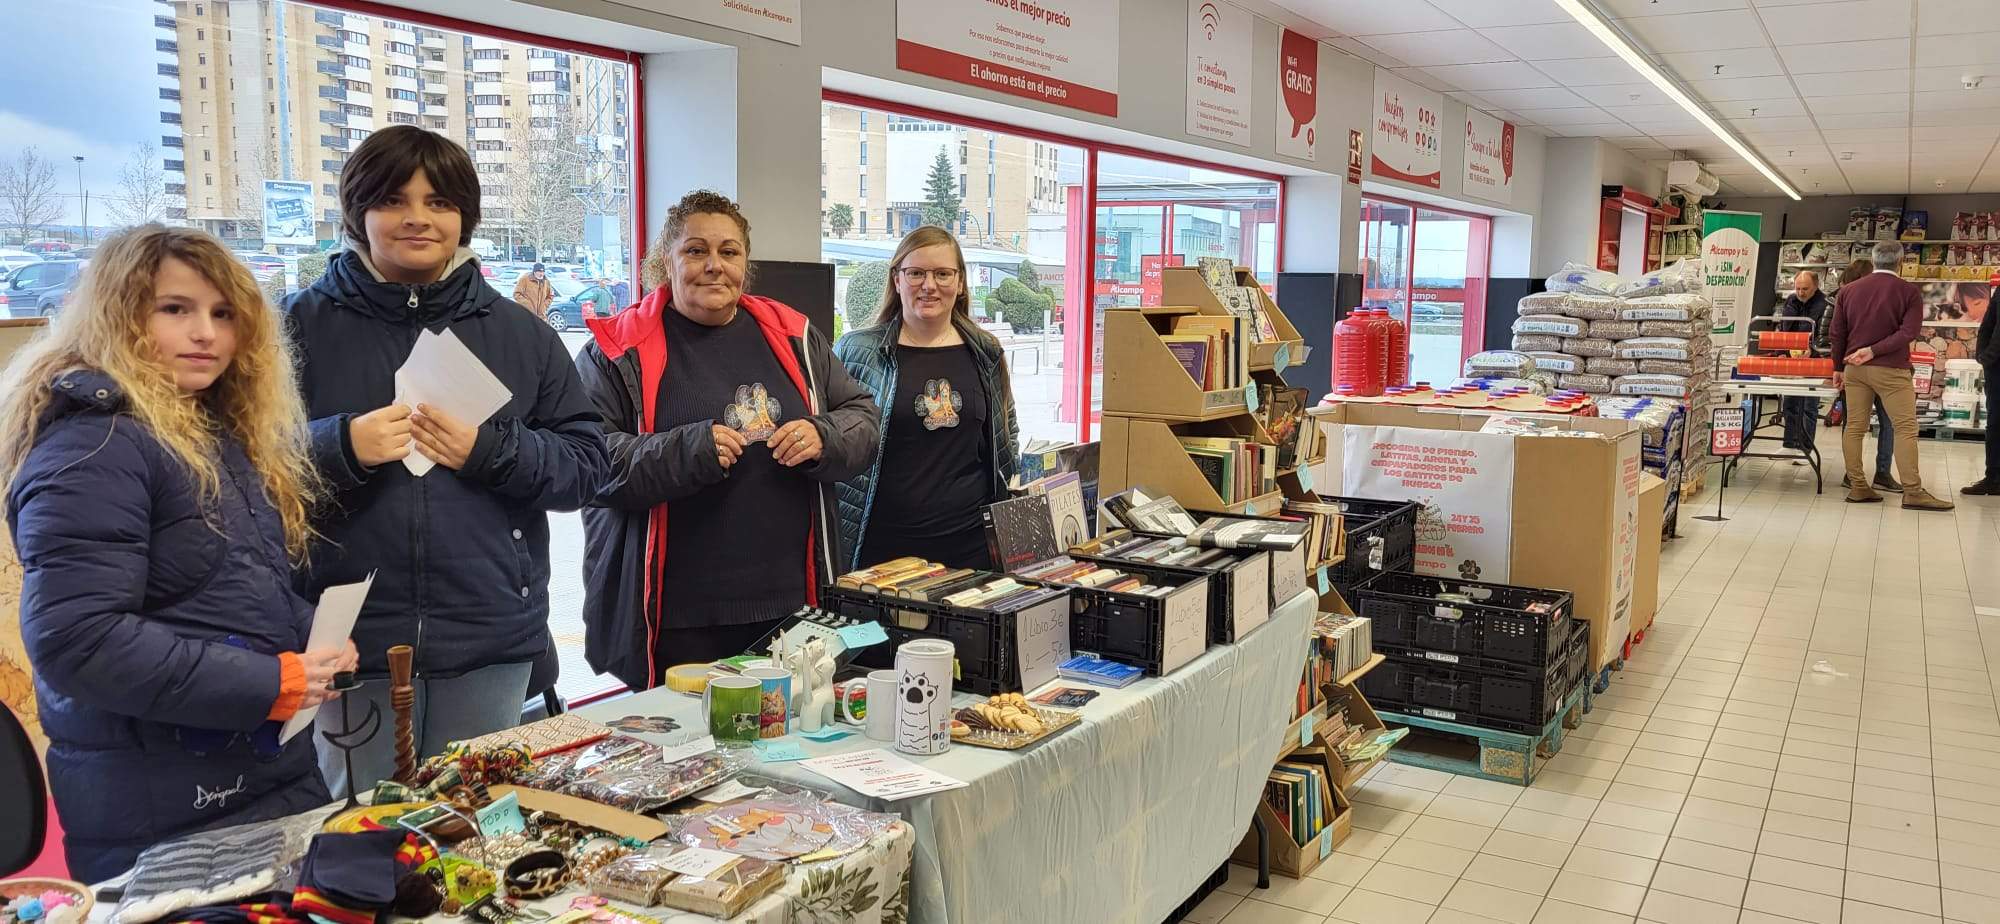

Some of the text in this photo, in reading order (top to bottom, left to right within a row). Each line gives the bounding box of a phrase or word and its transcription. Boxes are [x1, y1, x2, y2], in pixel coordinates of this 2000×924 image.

[1020, 2, 1045, 20] mejor
[1046, 10, 1071, 28] precio
[970, 64, 1067, 99] El ahorro está en el precio
[1203, 76, 1206, 85] 3
[1286, 69, 1312, 95] GRATIS
[1710, 244, 1736, 256] Alcampo
[1736, 249, 1740, 258] y
[1706, 274, 1747, 287] DESPERDICIO!
[1110, 284, 1144, 296] Alcampo
[1394, 290, 1436, 300] Alampo
[1384, 468, 1402, 477] LOS
[1448, 466, 1478, 474] PARA
[194, 774, 247, 810] Desigual
